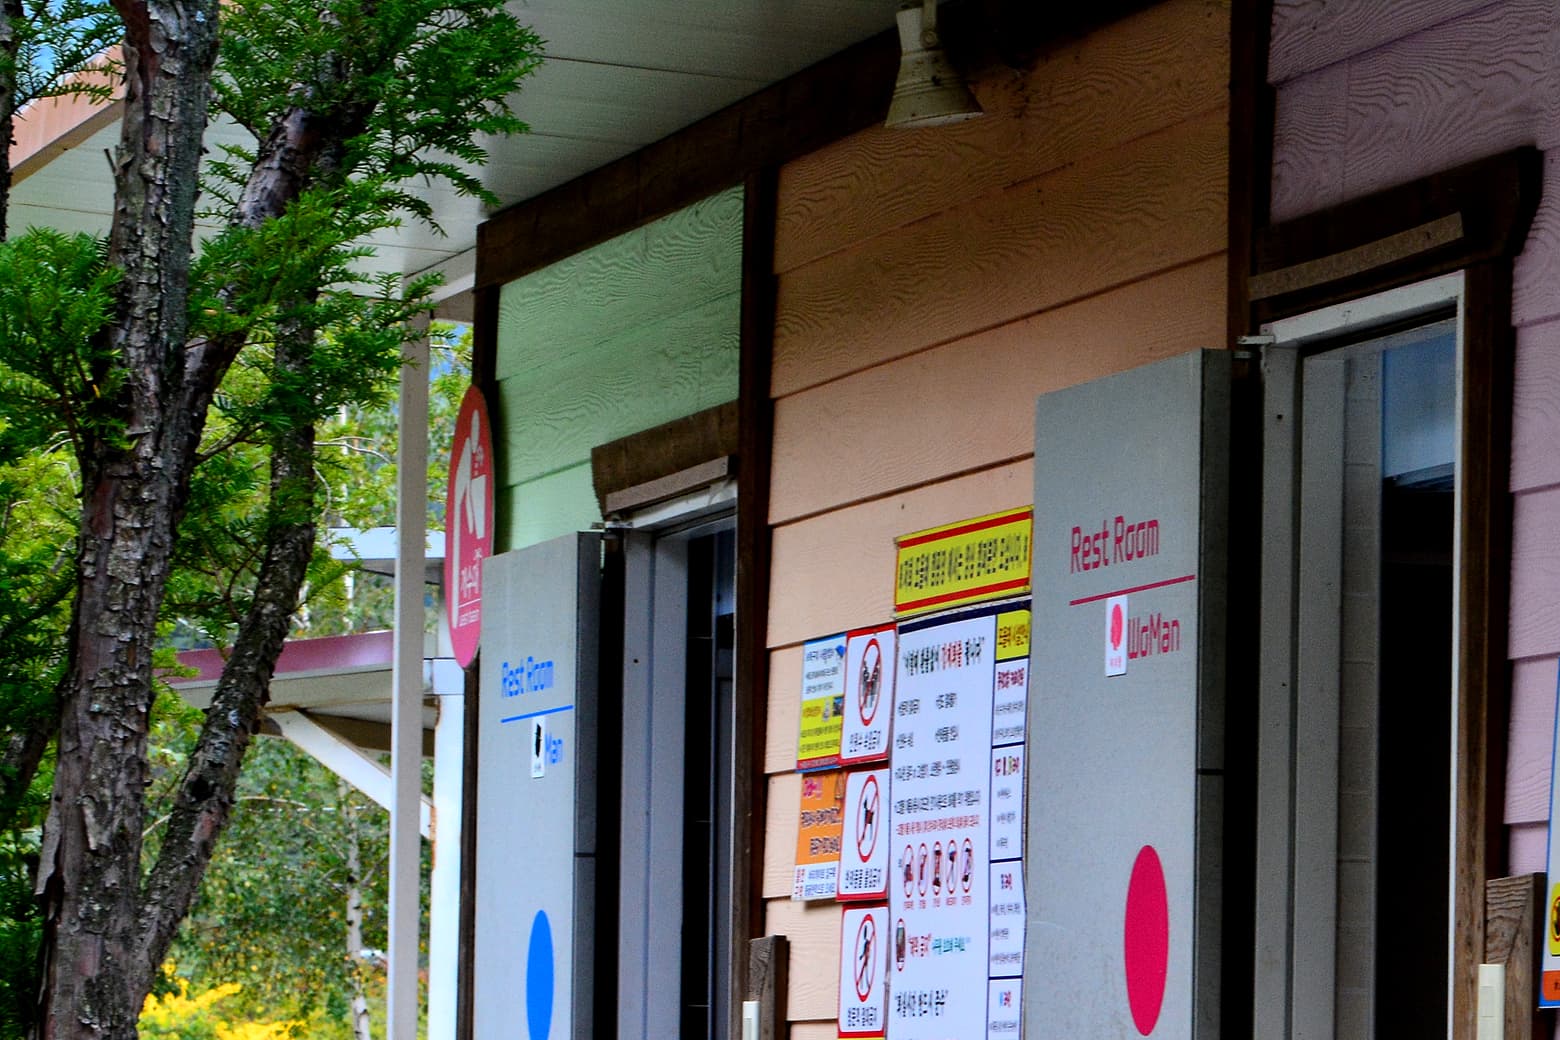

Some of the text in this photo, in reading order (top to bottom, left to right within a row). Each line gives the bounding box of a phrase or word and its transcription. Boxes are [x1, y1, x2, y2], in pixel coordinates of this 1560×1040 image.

[1071, 520, 1109, 573] Rest
[1113, 515, 1159, 564] Room
[1128, 612, 1180, 659] WoMan
[501, 656, 554, 698] Rest Room
[544, 732, 563, 766] Man
